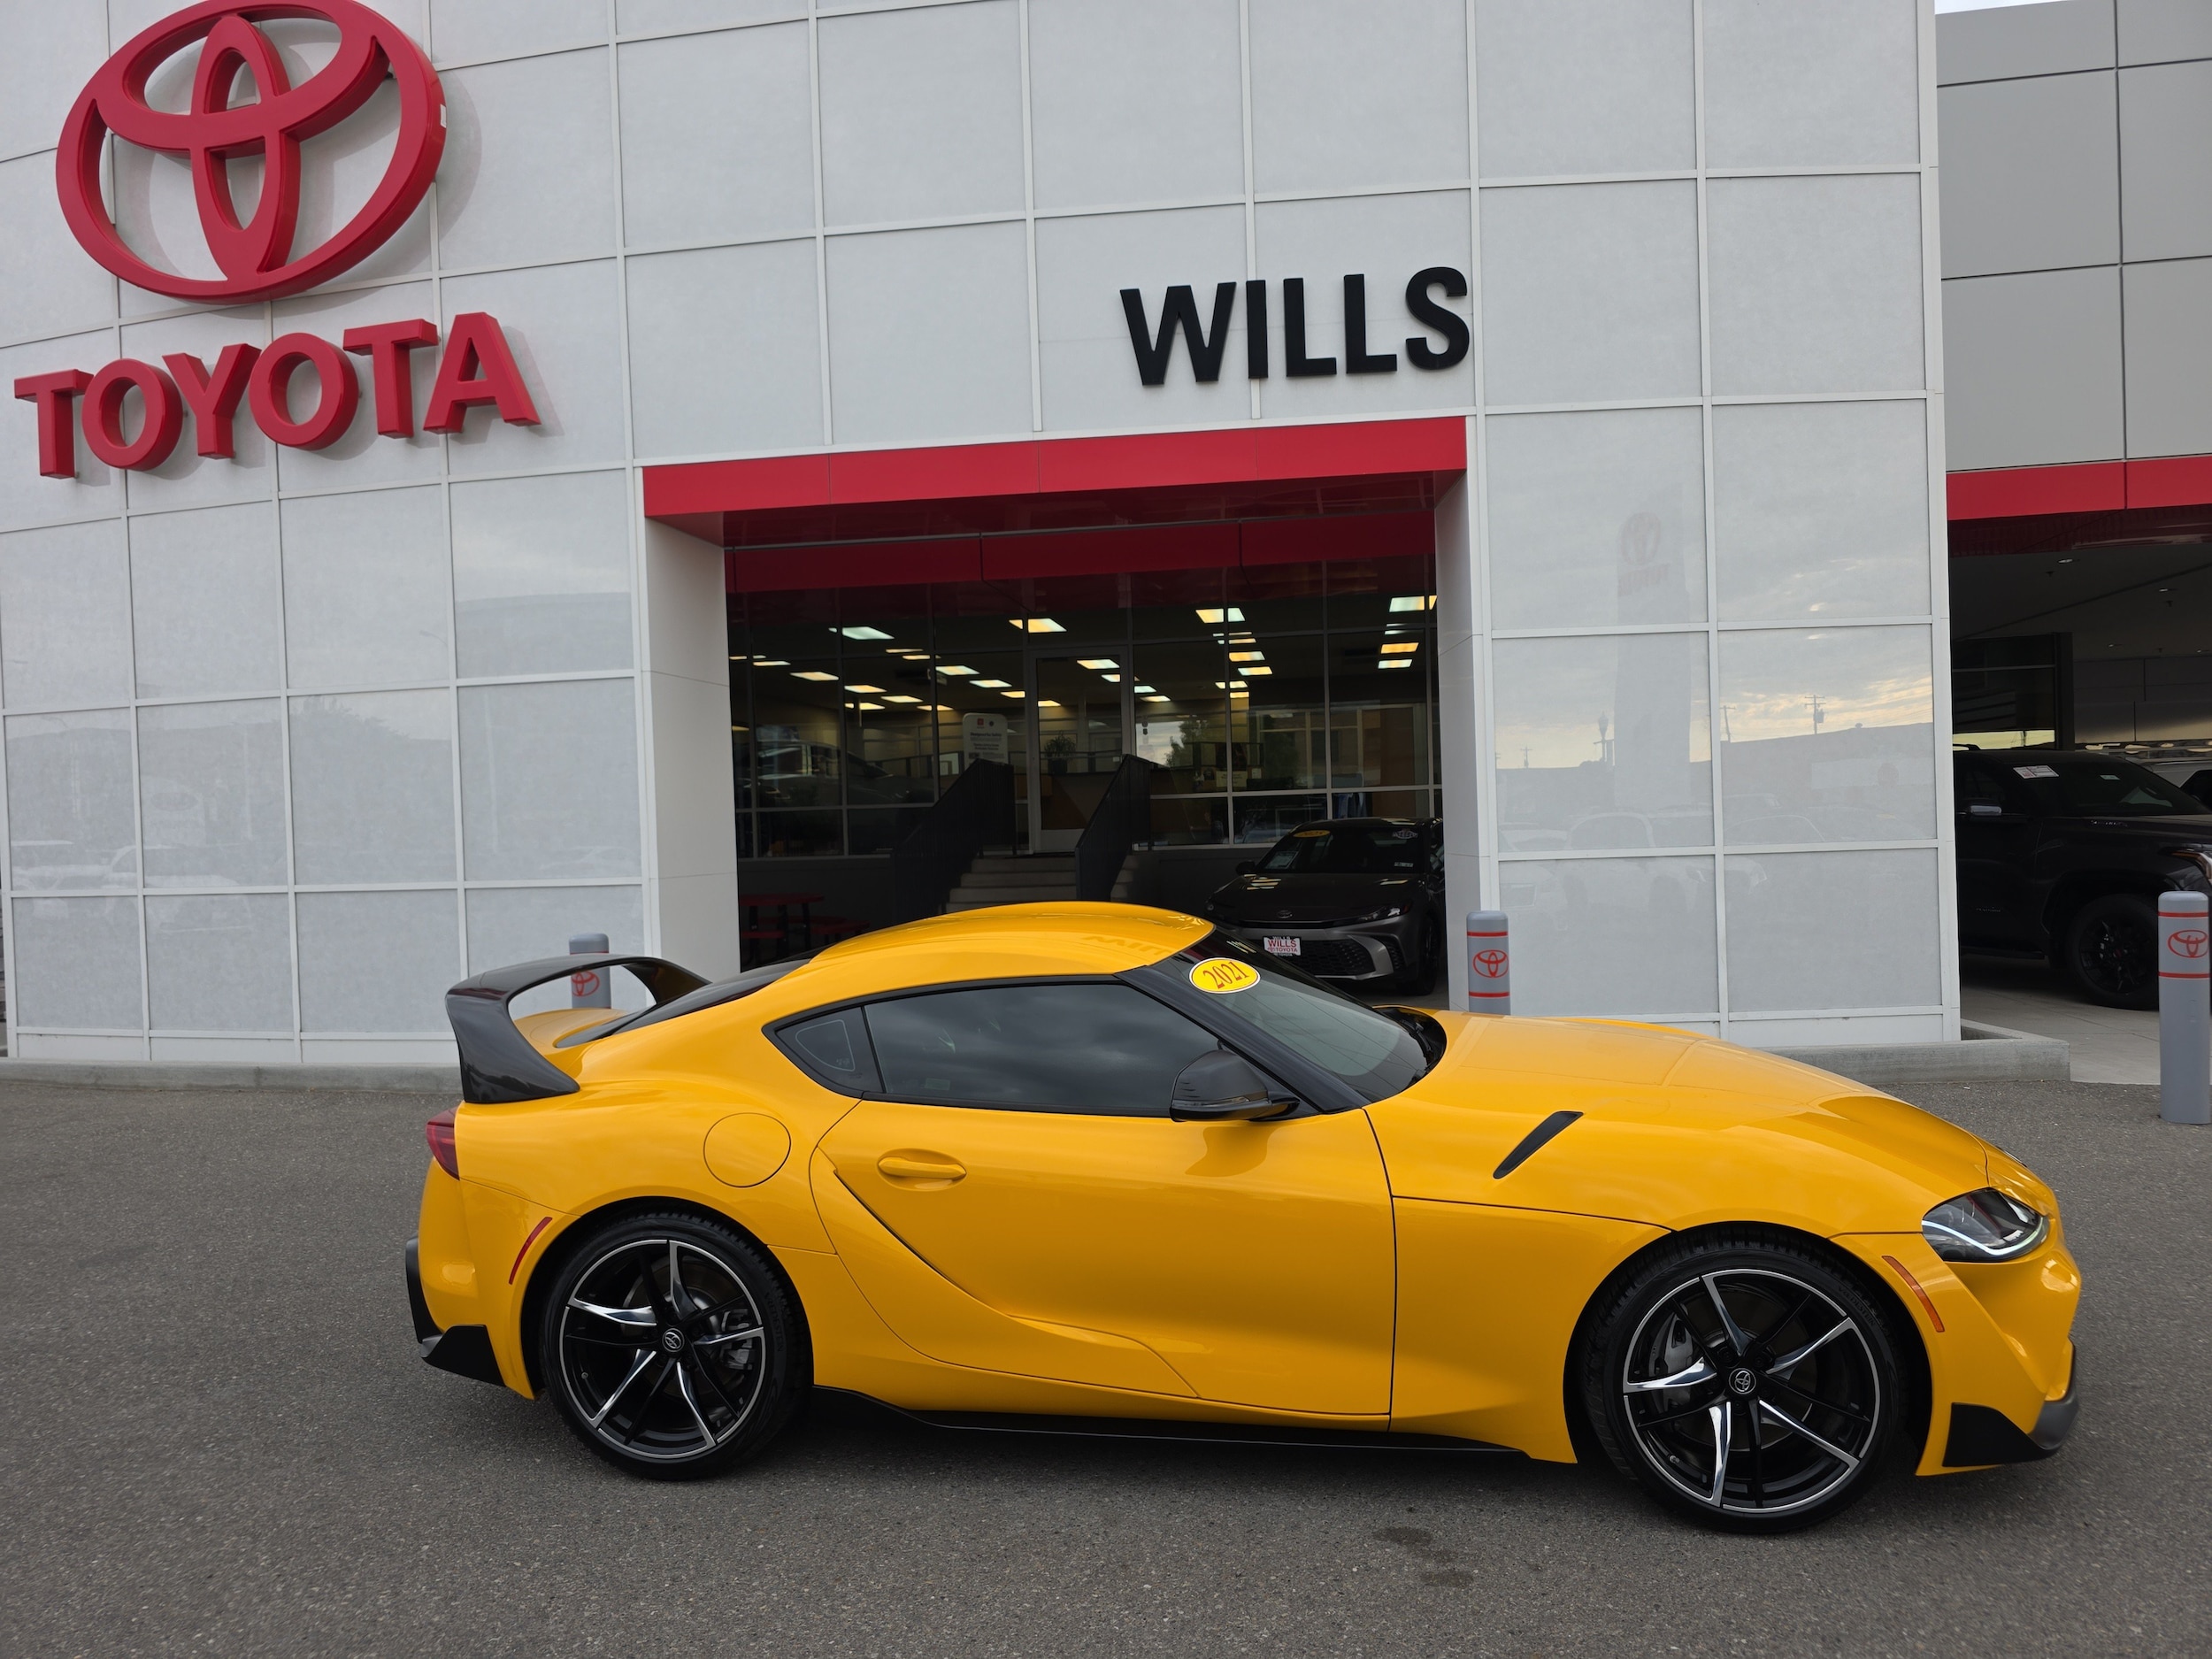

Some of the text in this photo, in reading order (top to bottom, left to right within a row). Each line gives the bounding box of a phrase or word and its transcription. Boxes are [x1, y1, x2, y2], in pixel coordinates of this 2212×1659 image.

[1119, 266, 1470, 386] WILLS
[14, 311, 541, 479] TOYOTA
[1203, 962, 1248, 988] 2021
[1268, 939, 1297, 948] WILLS
